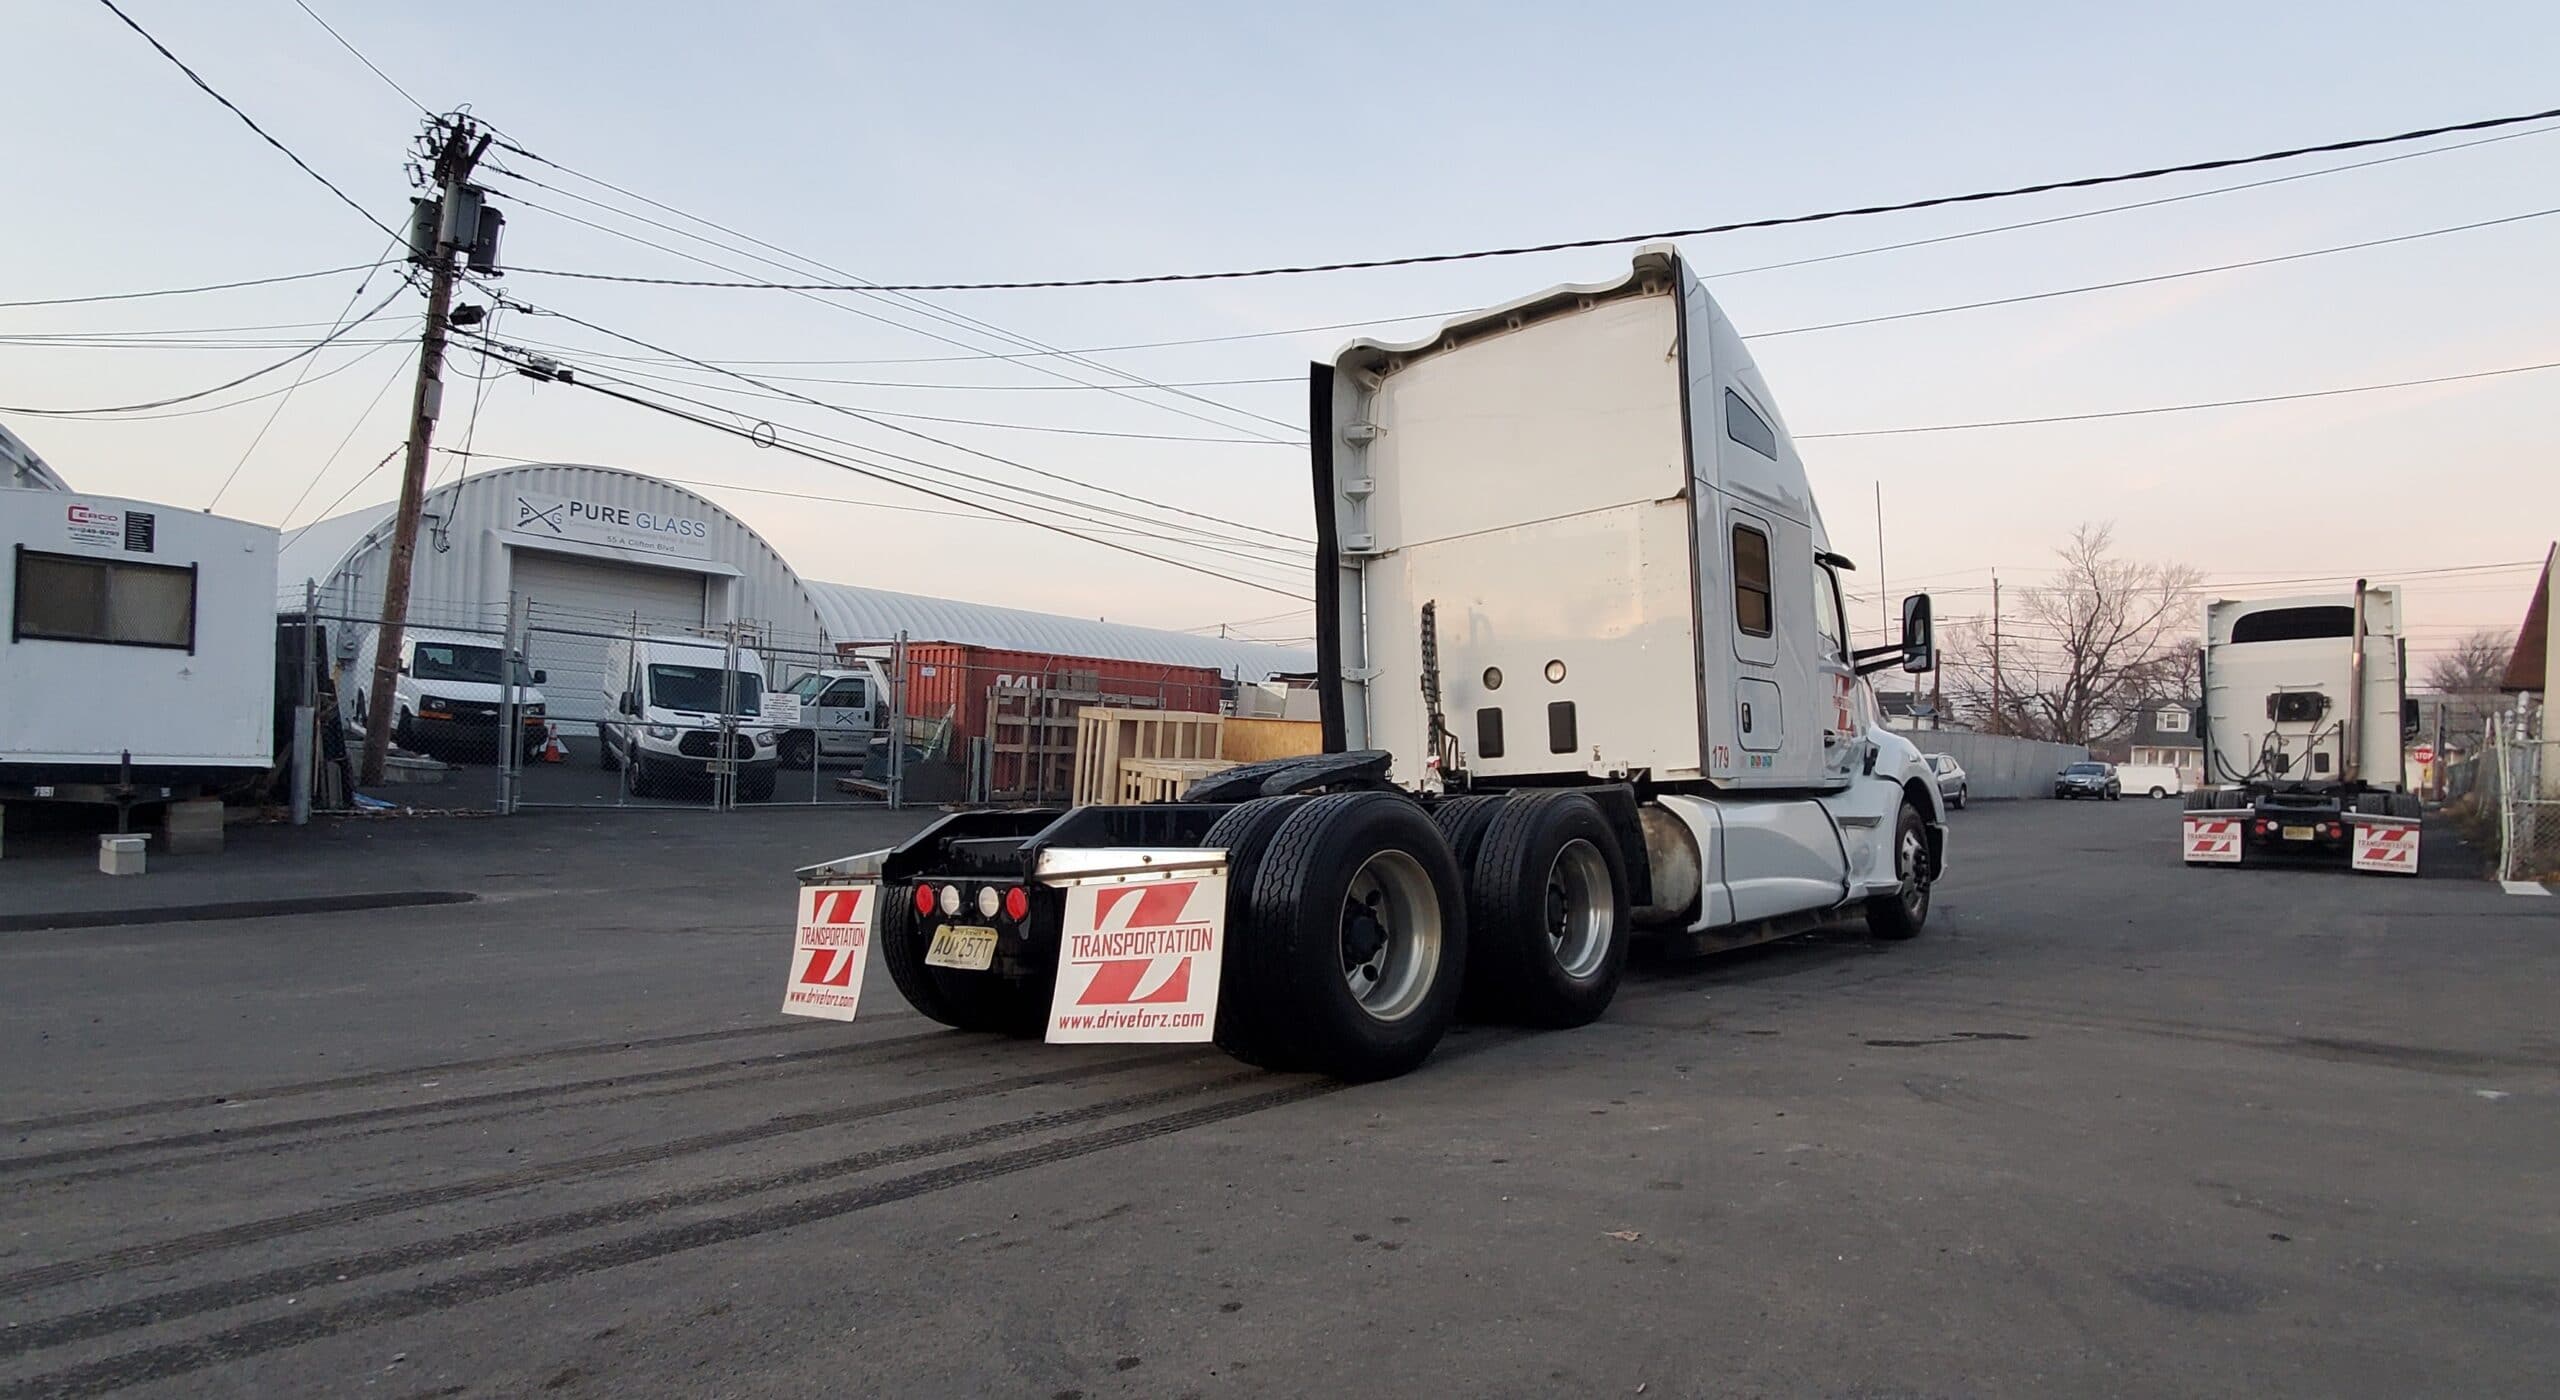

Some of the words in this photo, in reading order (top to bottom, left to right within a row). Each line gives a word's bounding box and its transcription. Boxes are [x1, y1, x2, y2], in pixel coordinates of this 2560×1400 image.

[570, 501, 630, 526] PURE
[636, 513, 706, 539] GLASS
[619, 537, 626, 545] A
[1712, 745, 1729, 769] 179
[2415, 752, 2433, 760] STOP
[801, 926, 866, 947] TRANSPORTATION
[958, 936, 993, 958] 257T
[1071, 927, 1213, 958] TRANSPORTATION
[790, 987, 855, 1008] www.driveforz.com
[1059, 1008, 1205, 1030] www.driveforz.com
